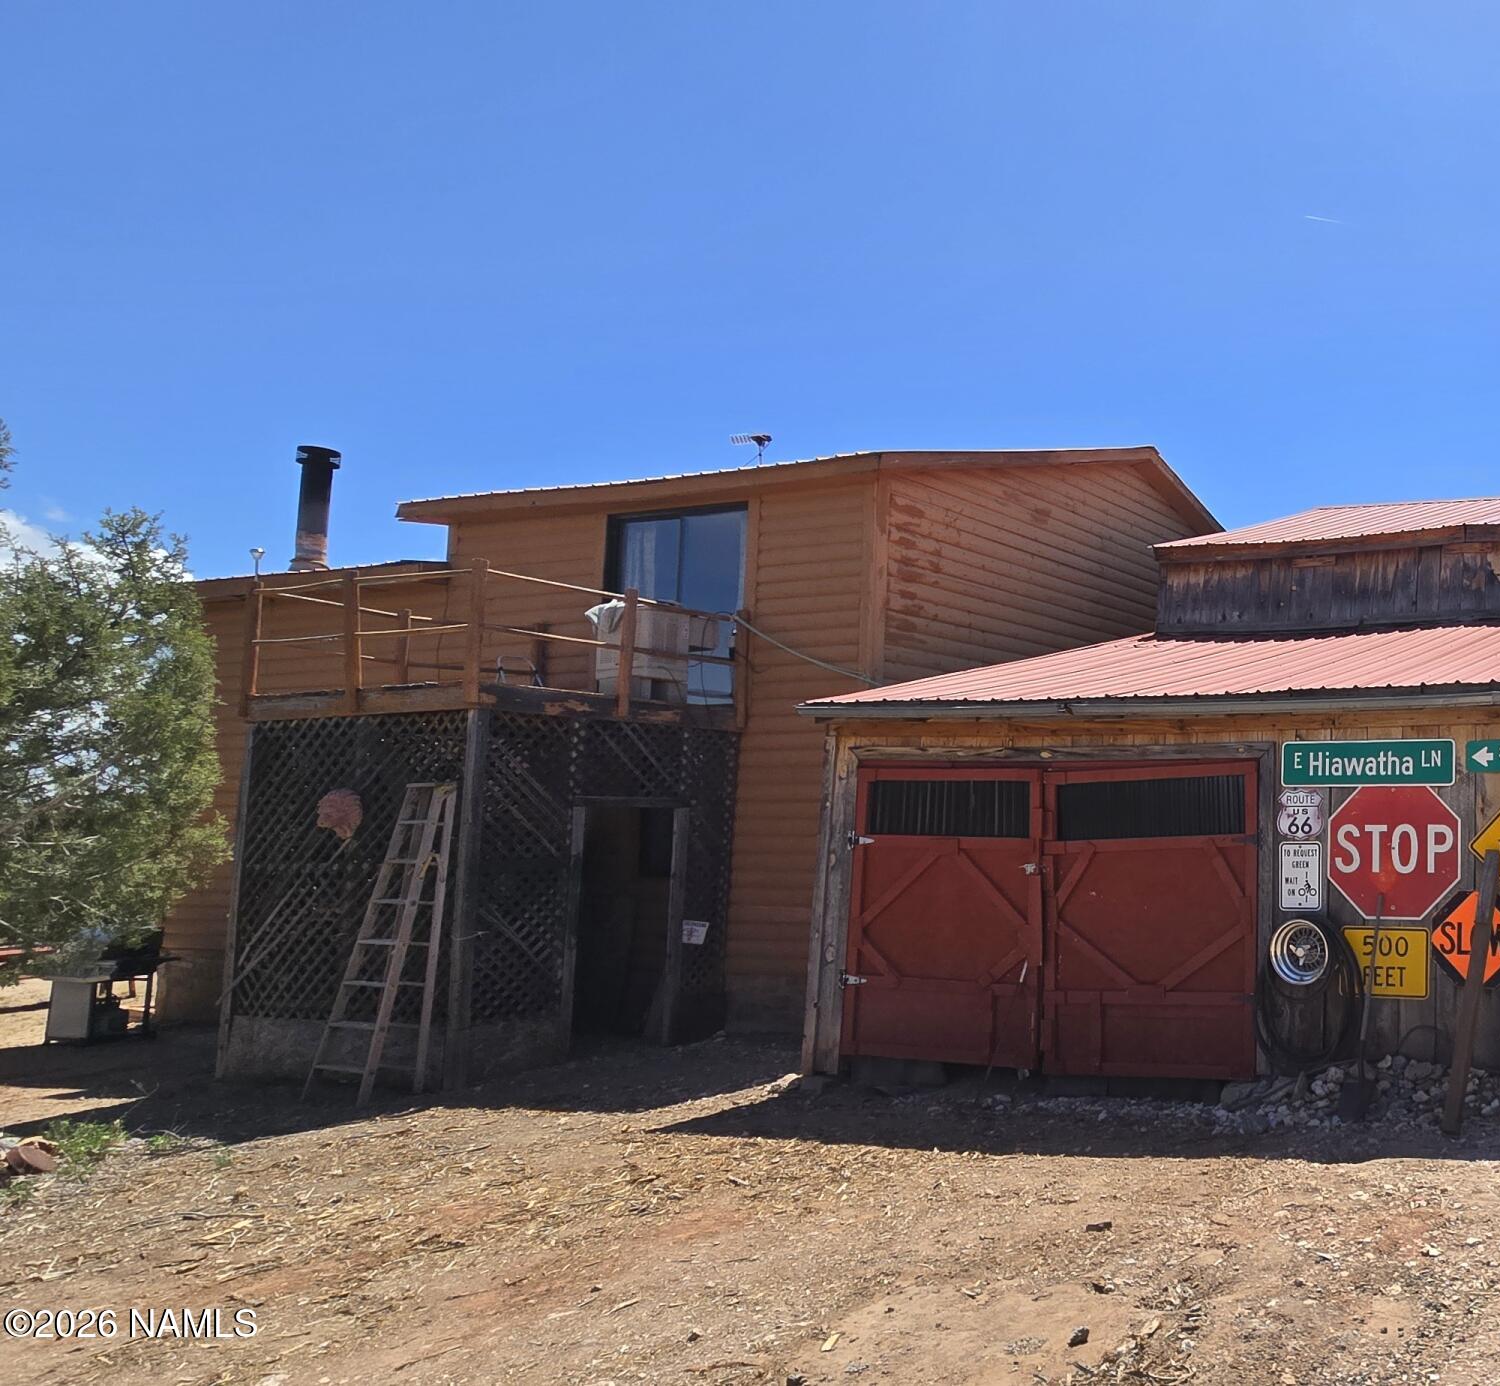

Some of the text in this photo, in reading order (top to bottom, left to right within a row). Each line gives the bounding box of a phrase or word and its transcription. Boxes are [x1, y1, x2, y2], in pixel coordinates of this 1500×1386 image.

[1294, 750, 1441, 776] E Hiawatha LN
[1286, 795, 1315, 804] ROUTE
[1288, 816, 1312, 835] 66
[1284, 849, 1318, 857] TO REQUEST
[1334, 824, 1454, 874] STOP
[1285, 877, 1298, 885] WAIT
[1363, 935, 1408, 957] 500
[1363, 965, 1406, 987] FEET
